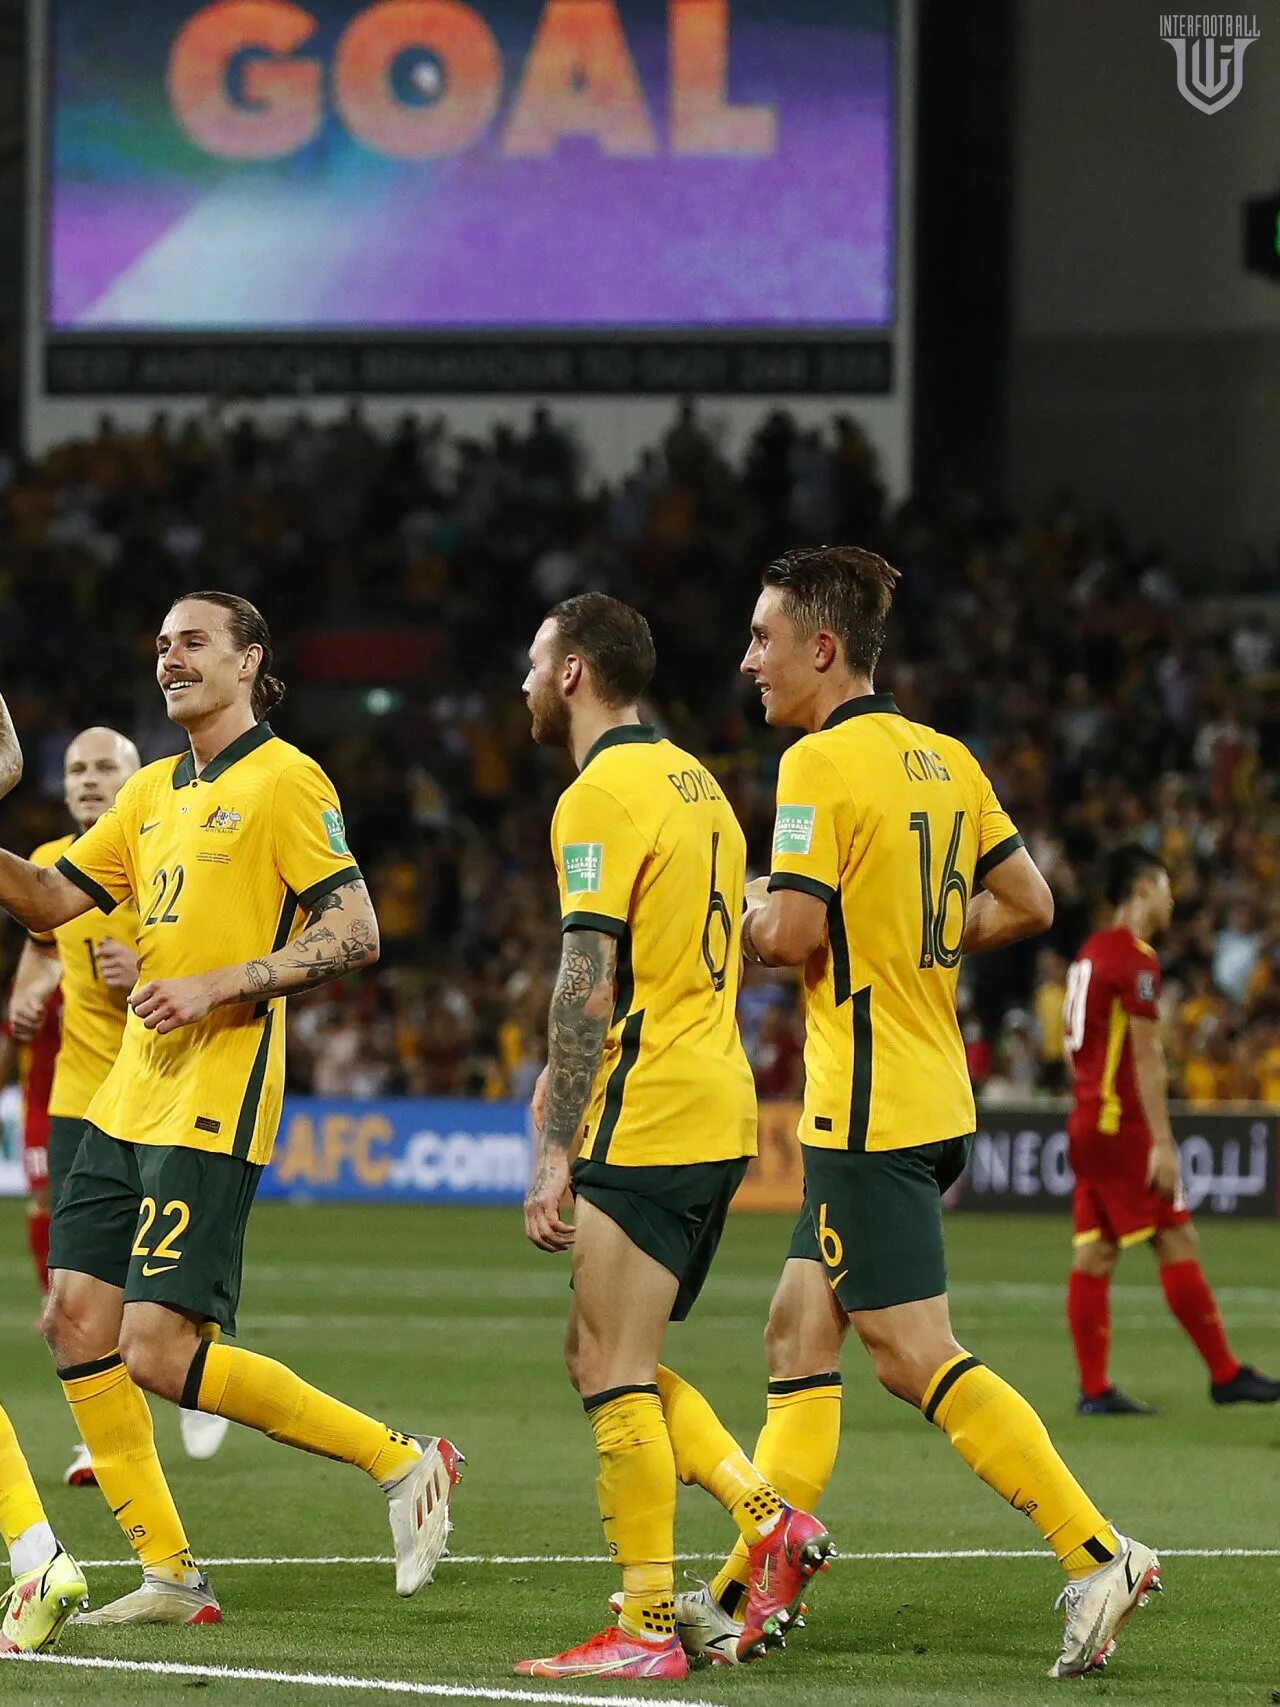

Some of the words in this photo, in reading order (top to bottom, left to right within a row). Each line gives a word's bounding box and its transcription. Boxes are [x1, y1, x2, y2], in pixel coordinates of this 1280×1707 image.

[166, 0, 777, 160] GOAL
[667, 768, 722, 803] BOYLE
[898, 749, 951, 783] KING
[790, 833, 807, 841] FIFA
[144, 864, 185, 927] 22
[701, 831, 732, 992] 6
[909, 810, 967, 969] 16
[274, 1113, 527, 1192] AFC.com
[972, 1130, 1076, 1197] NEO
[131, 1196, 191, 1260] 22
[124, 1524, 147, 1542] US
